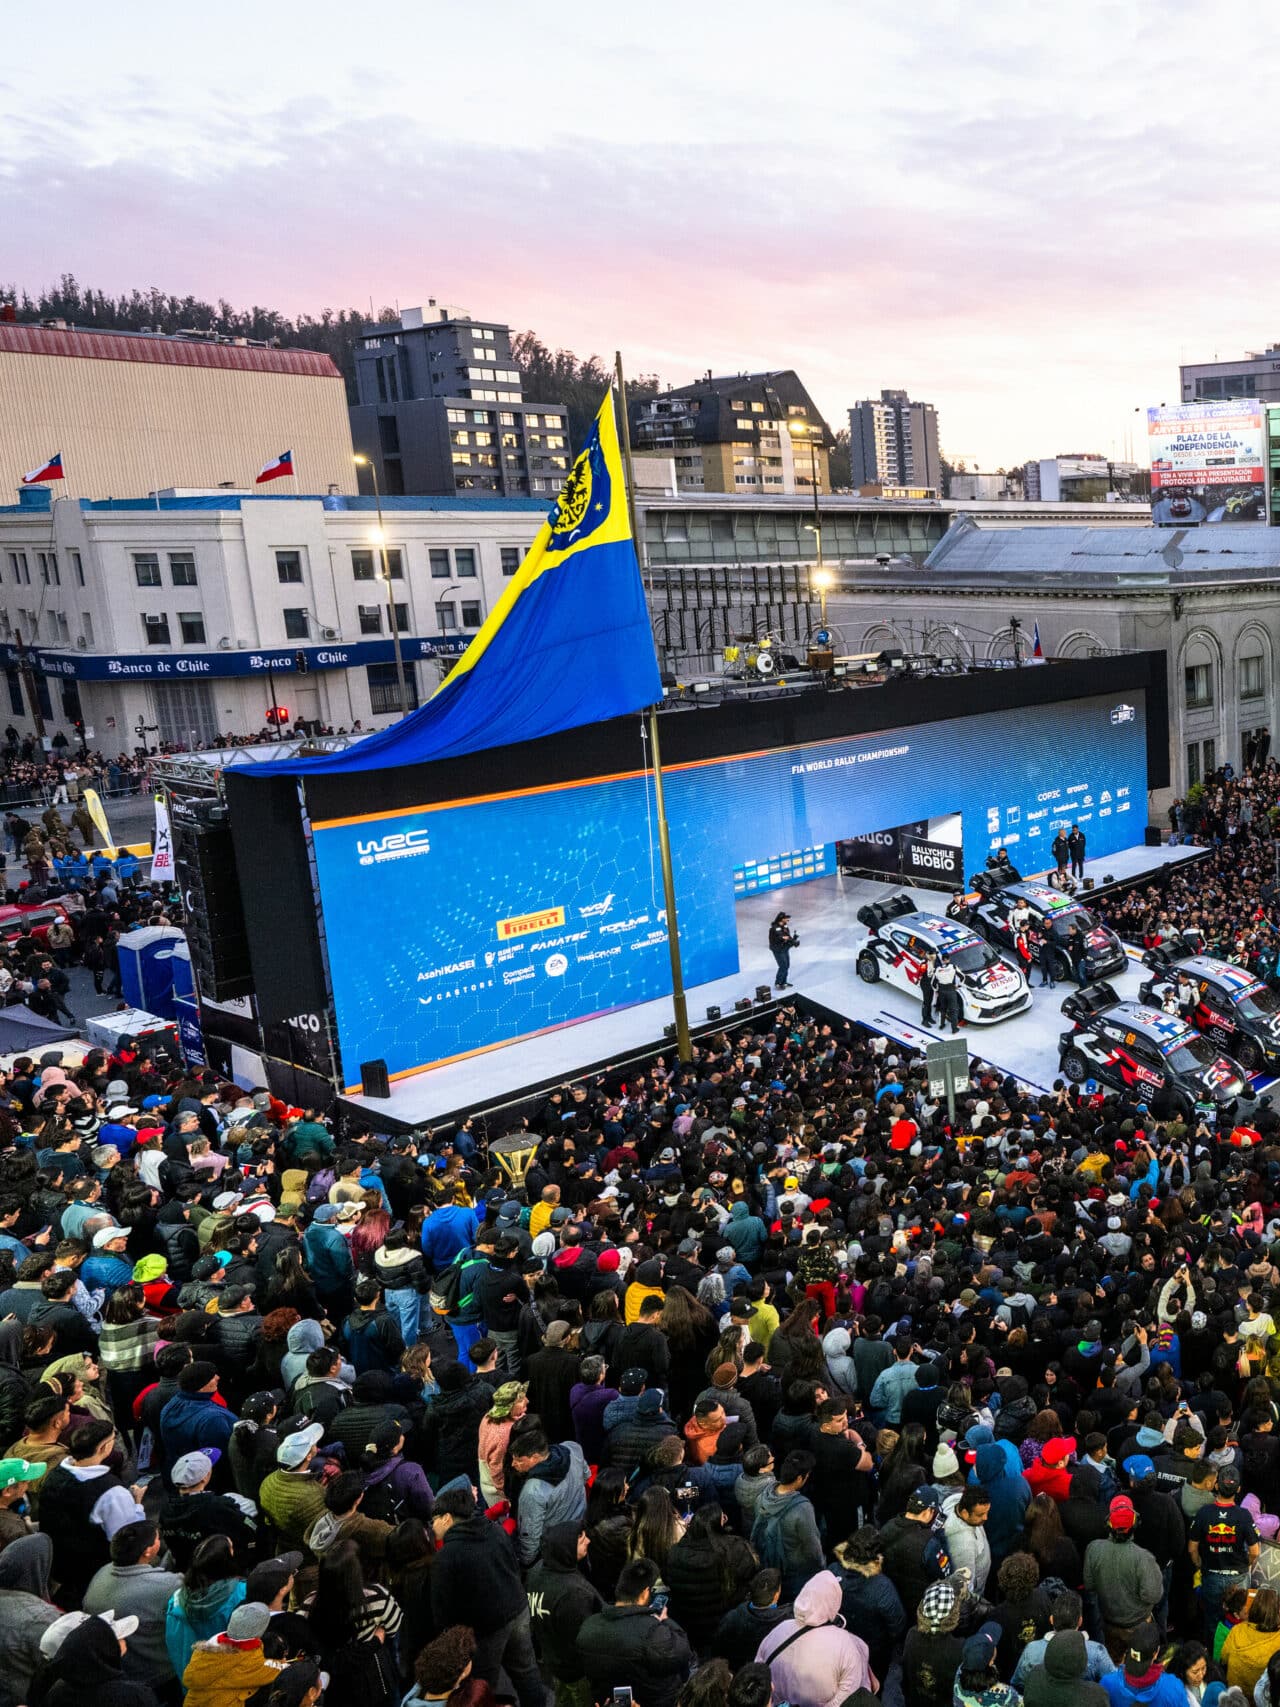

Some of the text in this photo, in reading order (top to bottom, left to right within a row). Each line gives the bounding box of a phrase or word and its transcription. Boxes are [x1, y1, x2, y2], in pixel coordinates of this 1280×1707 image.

[1177, 432, 1231, 442] PLAZA DE LA
[1170, 441, 1239, 452] INDEPENDENCIA
[1160, 475, 1252, 486] PROTOCOLAR INOLVIDABLE
[250, 656, 292, 668] Banco
[317, 652, 348, 664] Chile
[108, 659, 211, 674] Banco de Chile
[792, 745, 910, 774] FIA WORLD RALLY CHAMPIONSHIP
[1038, 790, 1061, 802] COPEC
[357, 829, 429, 854] WRC
[911, 844, 955, 859] RALLYCHILE
[504, 911, 558, 935] PIRELLI
[530, 930, 591, 952] FANATEC
[416, 959, 475, 982] AsahiKASEI
[503, 964, 535, 979] Compact
[504, 972, 536, 985] Dynamics
[990, 977, 1014, 990] DENSO
[436, 979, 493, 1001] CASTORE
[1125, 1032, 1137, 1045] 69
[1140, 1082, 1155, 1094] CCI
